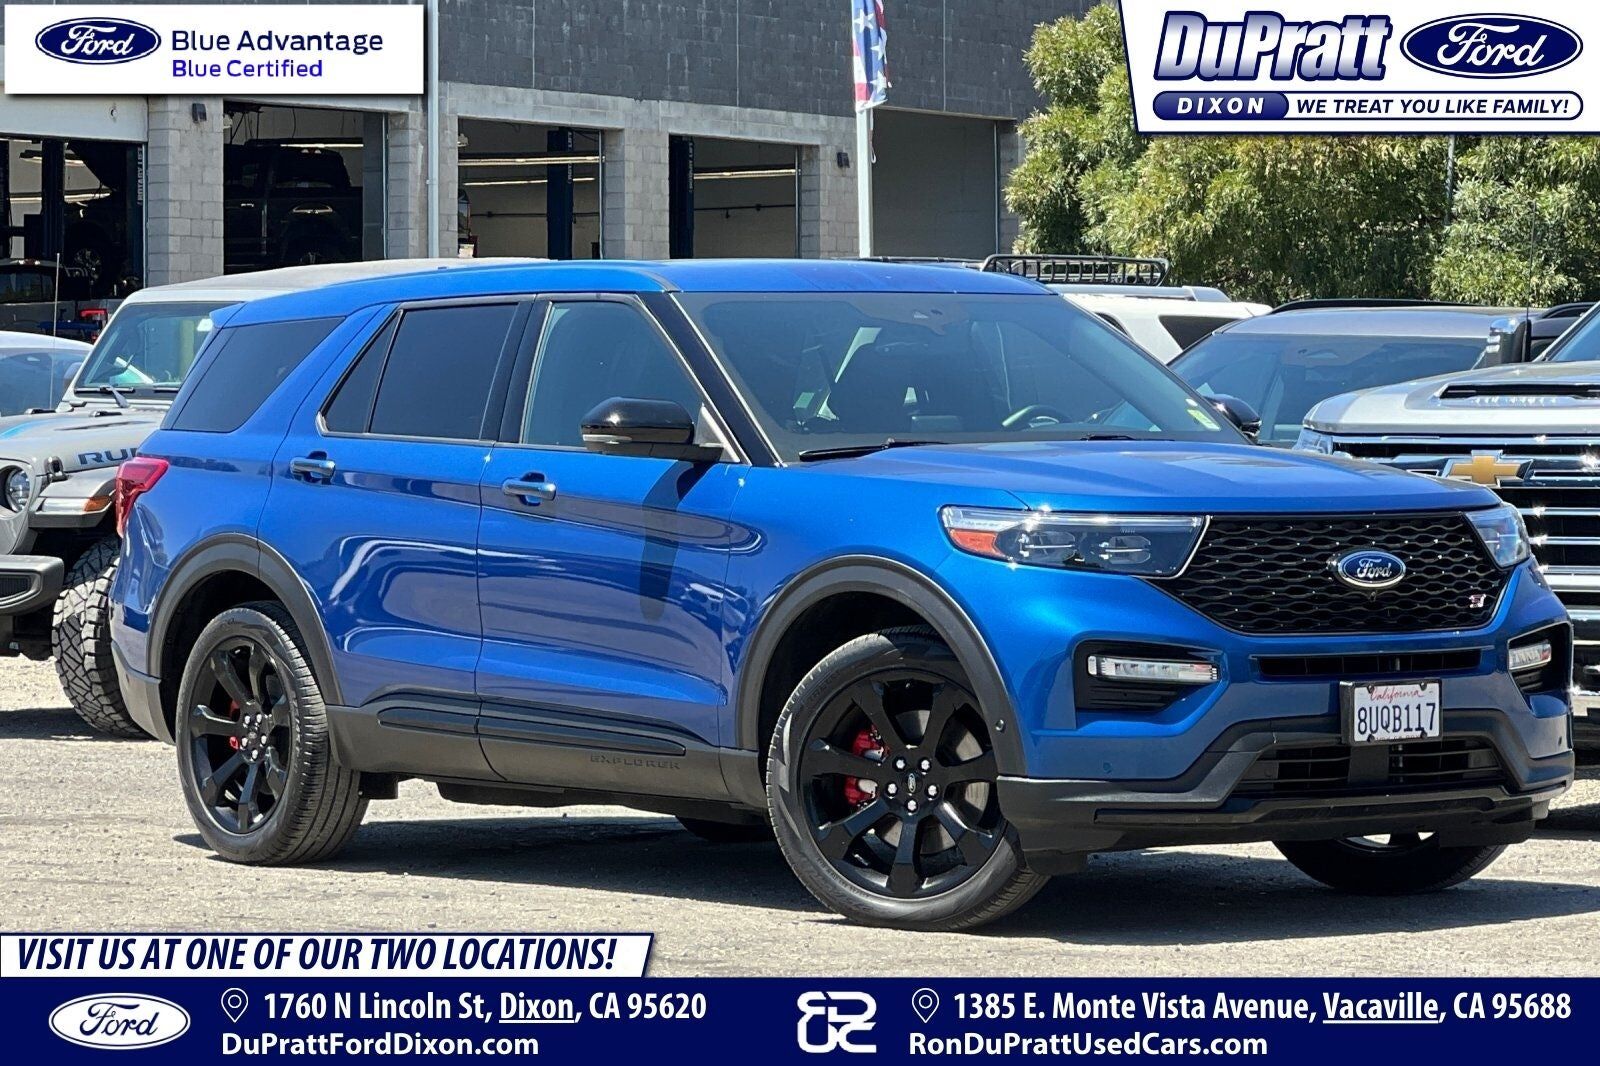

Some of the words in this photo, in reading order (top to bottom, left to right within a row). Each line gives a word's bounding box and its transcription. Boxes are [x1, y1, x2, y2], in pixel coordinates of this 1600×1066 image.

[1356, 558, 1392, 578] Ford
[1369, 687, 1424, 703] California
[1357, 702, 1436, 735] 8UQB117
[590, 754, 681, 769] EXPLORER
